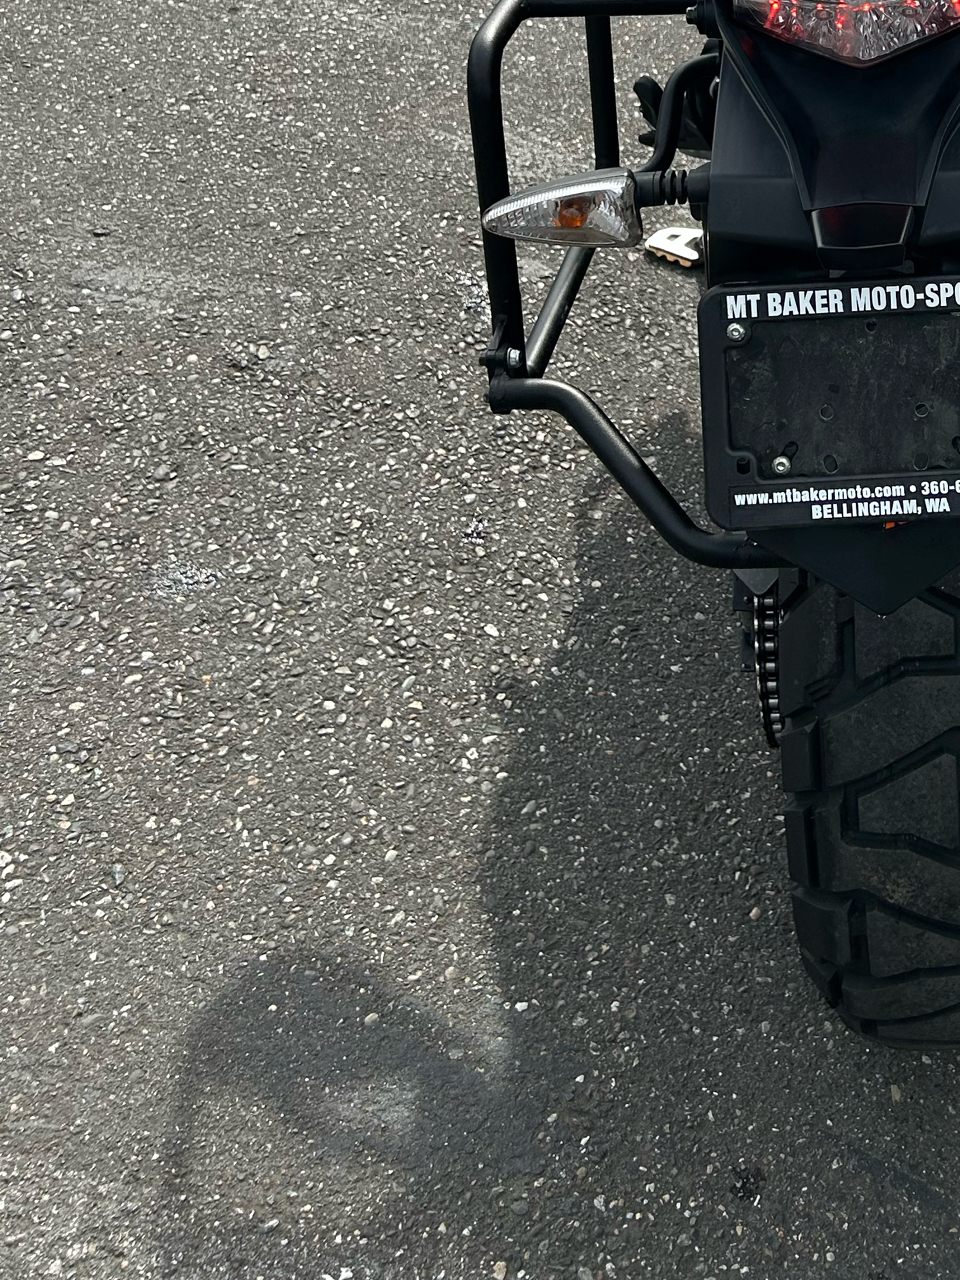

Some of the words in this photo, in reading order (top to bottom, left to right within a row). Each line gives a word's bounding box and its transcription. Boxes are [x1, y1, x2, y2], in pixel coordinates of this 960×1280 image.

[726, 294, 761, 319] MT
[767, 289, 844, 317] BAKER
[734, 485, 905, 506] www.mtbakermoto.com
[811, 499, 922, 519] BELLINGHAM,
[924, 497, 951, 513] WA
